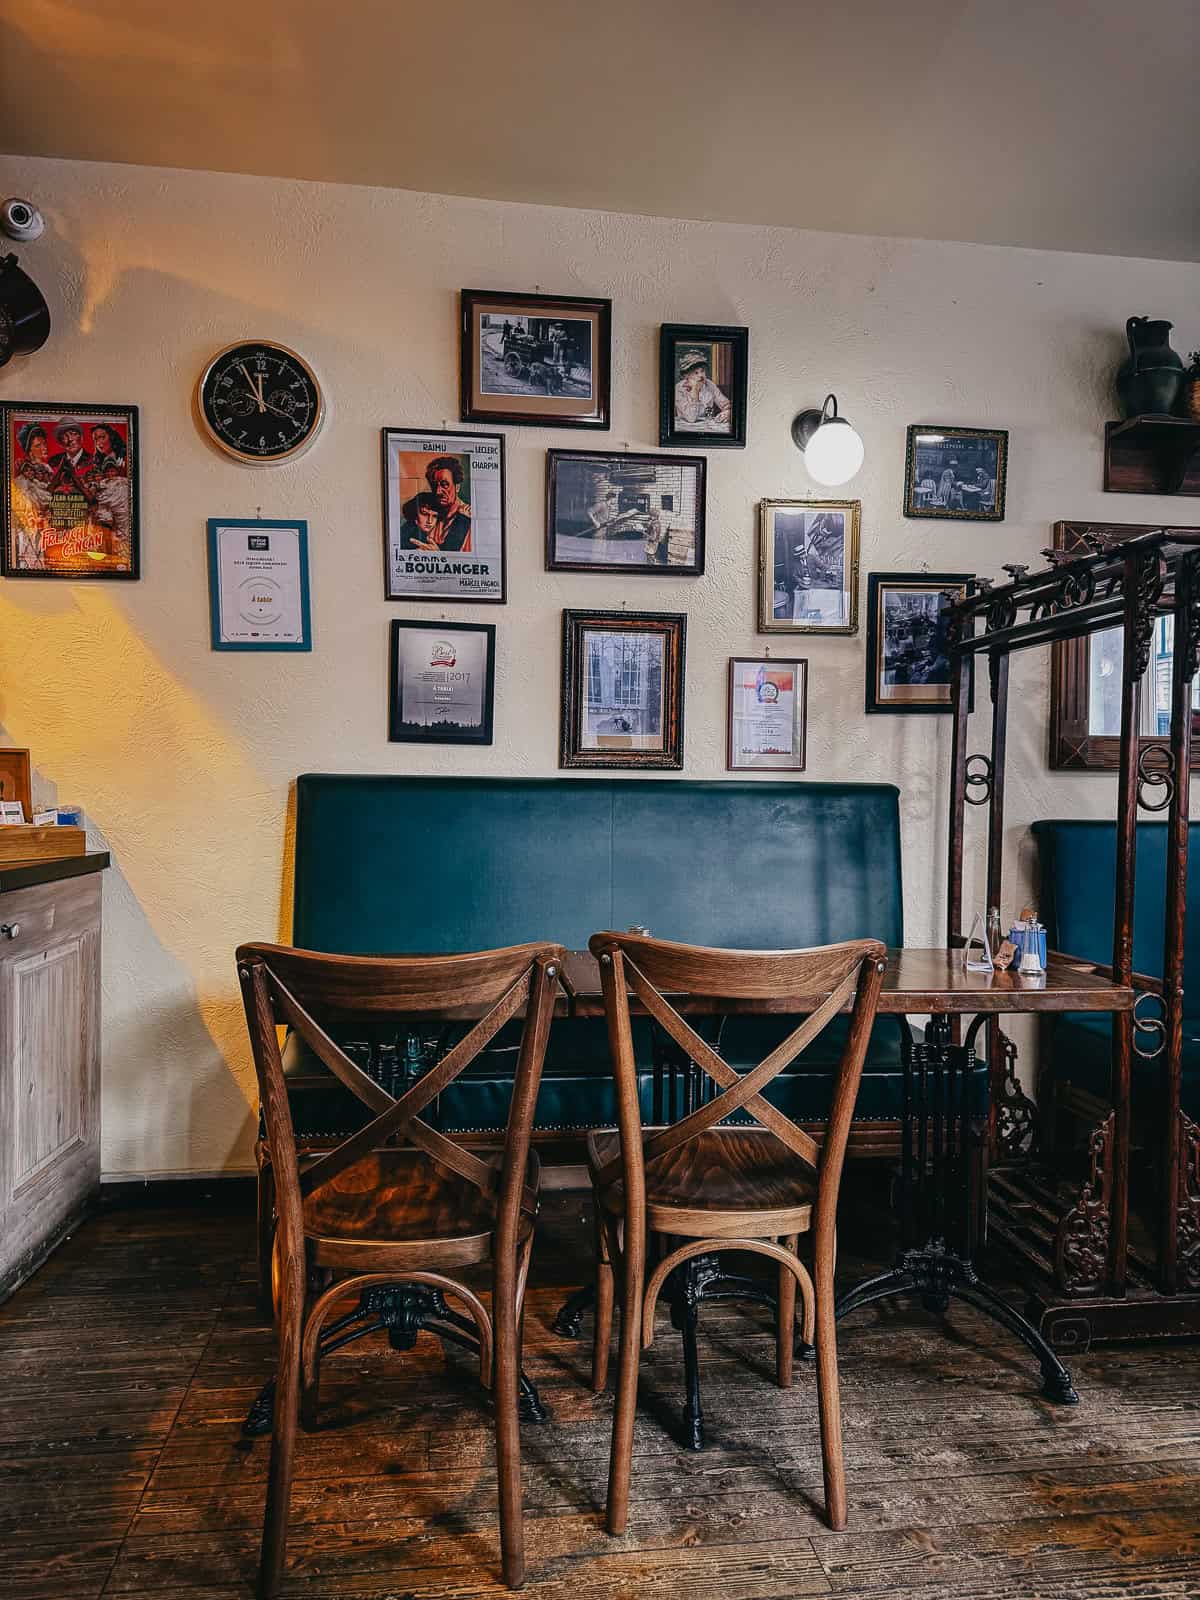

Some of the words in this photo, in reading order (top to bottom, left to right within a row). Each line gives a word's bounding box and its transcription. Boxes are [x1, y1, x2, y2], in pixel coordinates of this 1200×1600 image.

[256, 360, 267, 370] 12
[278, 366, 285, 376] 1
[221, 377, 234, 388] 10
[289, 382, 300, 391] 2
[238, 430, 248, 440] 7
[278, 432, 286, 442] 5
[259, 436, 266, 446] 6
[423, 443, 447, 452] RAIMU
[475, 446, 498, 455] LECLERC
[472, 461, 499, 470] CHARPIN
[41, 527, 89, 552] FRENCH
[62, 530, 104, 559] CANCAN
[395, 548, 405, 561] la
[405, 562, 490, 575] BOULANGER
